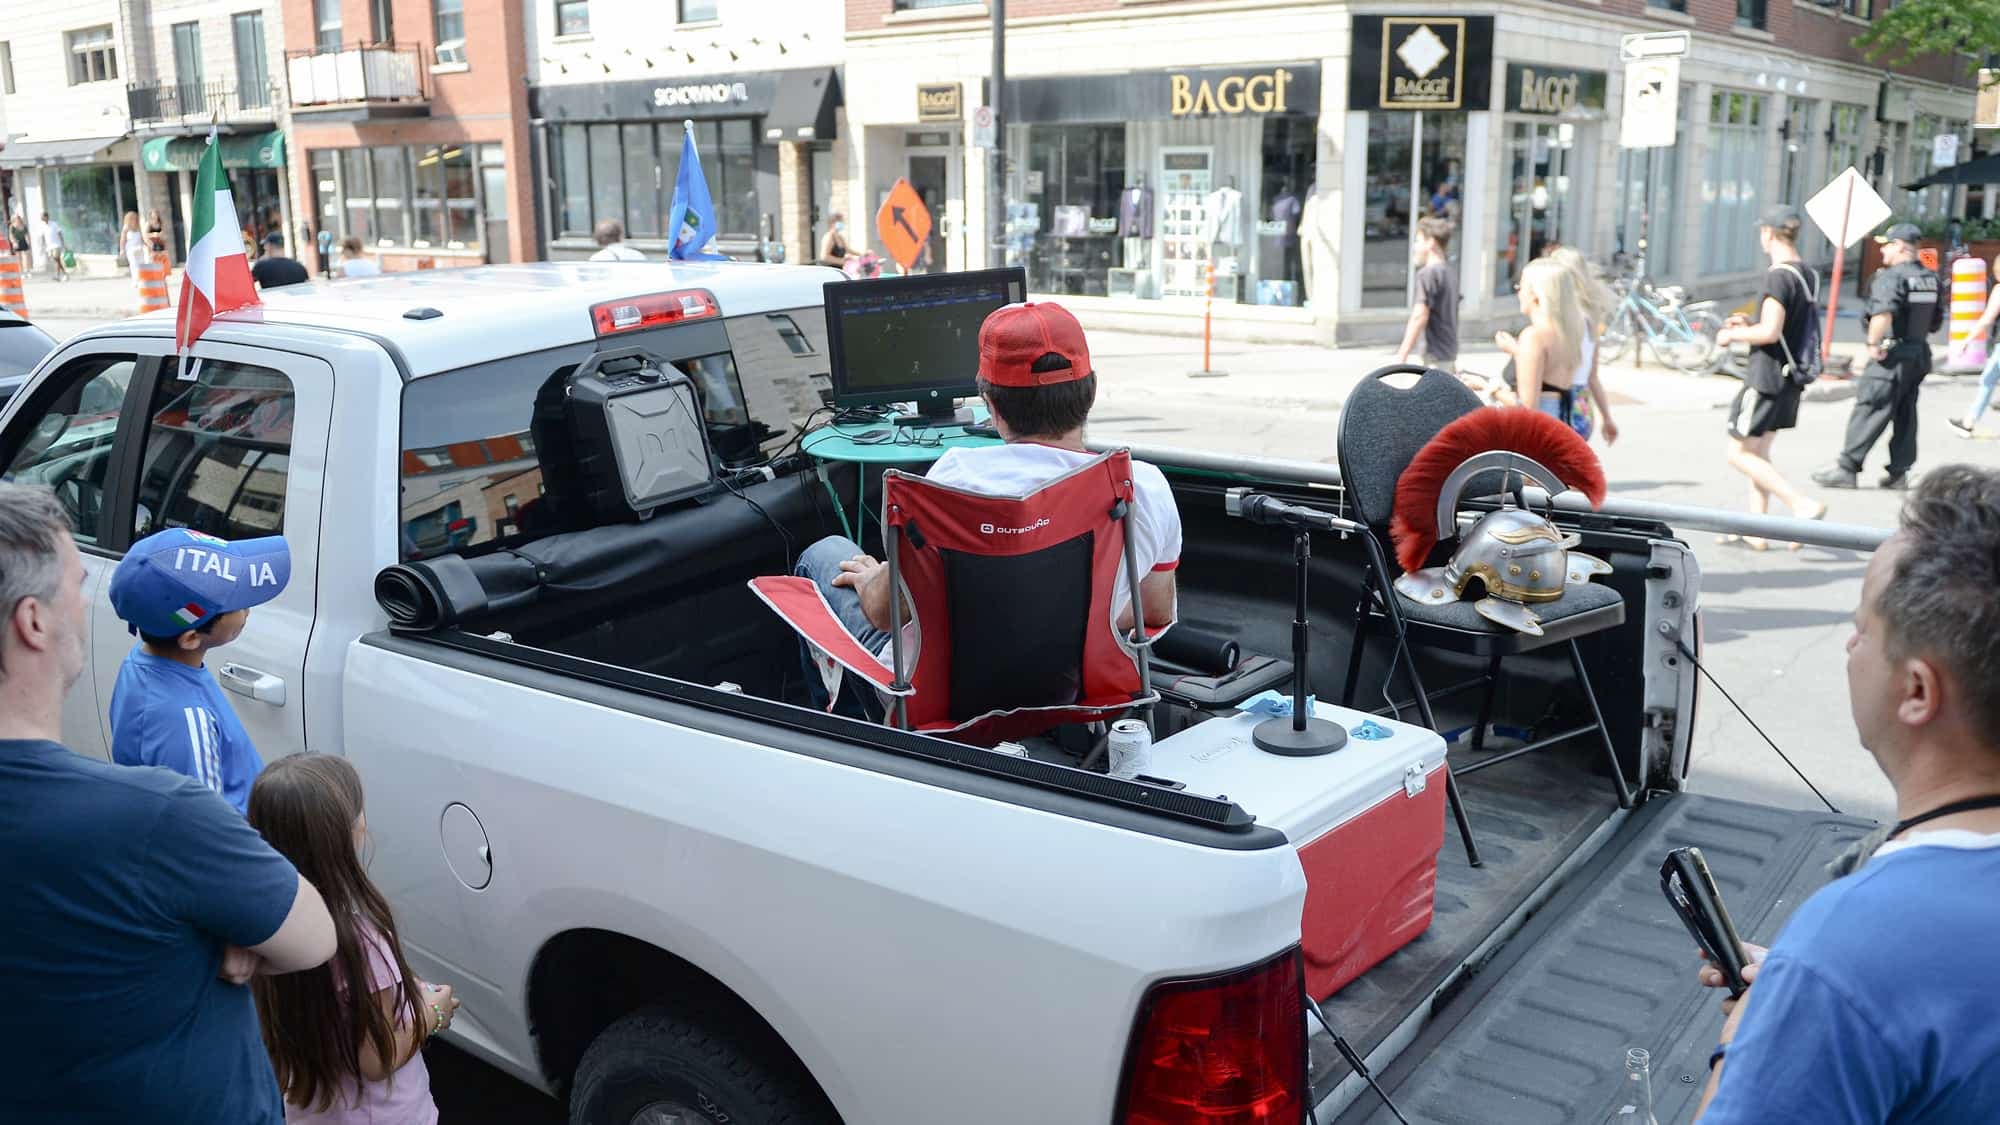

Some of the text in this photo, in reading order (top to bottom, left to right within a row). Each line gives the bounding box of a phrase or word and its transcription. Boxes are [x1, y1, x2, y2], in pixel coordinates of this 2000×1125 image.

[1170, 68, 1288, 115] BAGGI
[1394, 76, 1449, 96] BAGGI
[1521, 68, 1578, 111] BAGGI
[997, 518, 1050, 534] OUTBOUND
